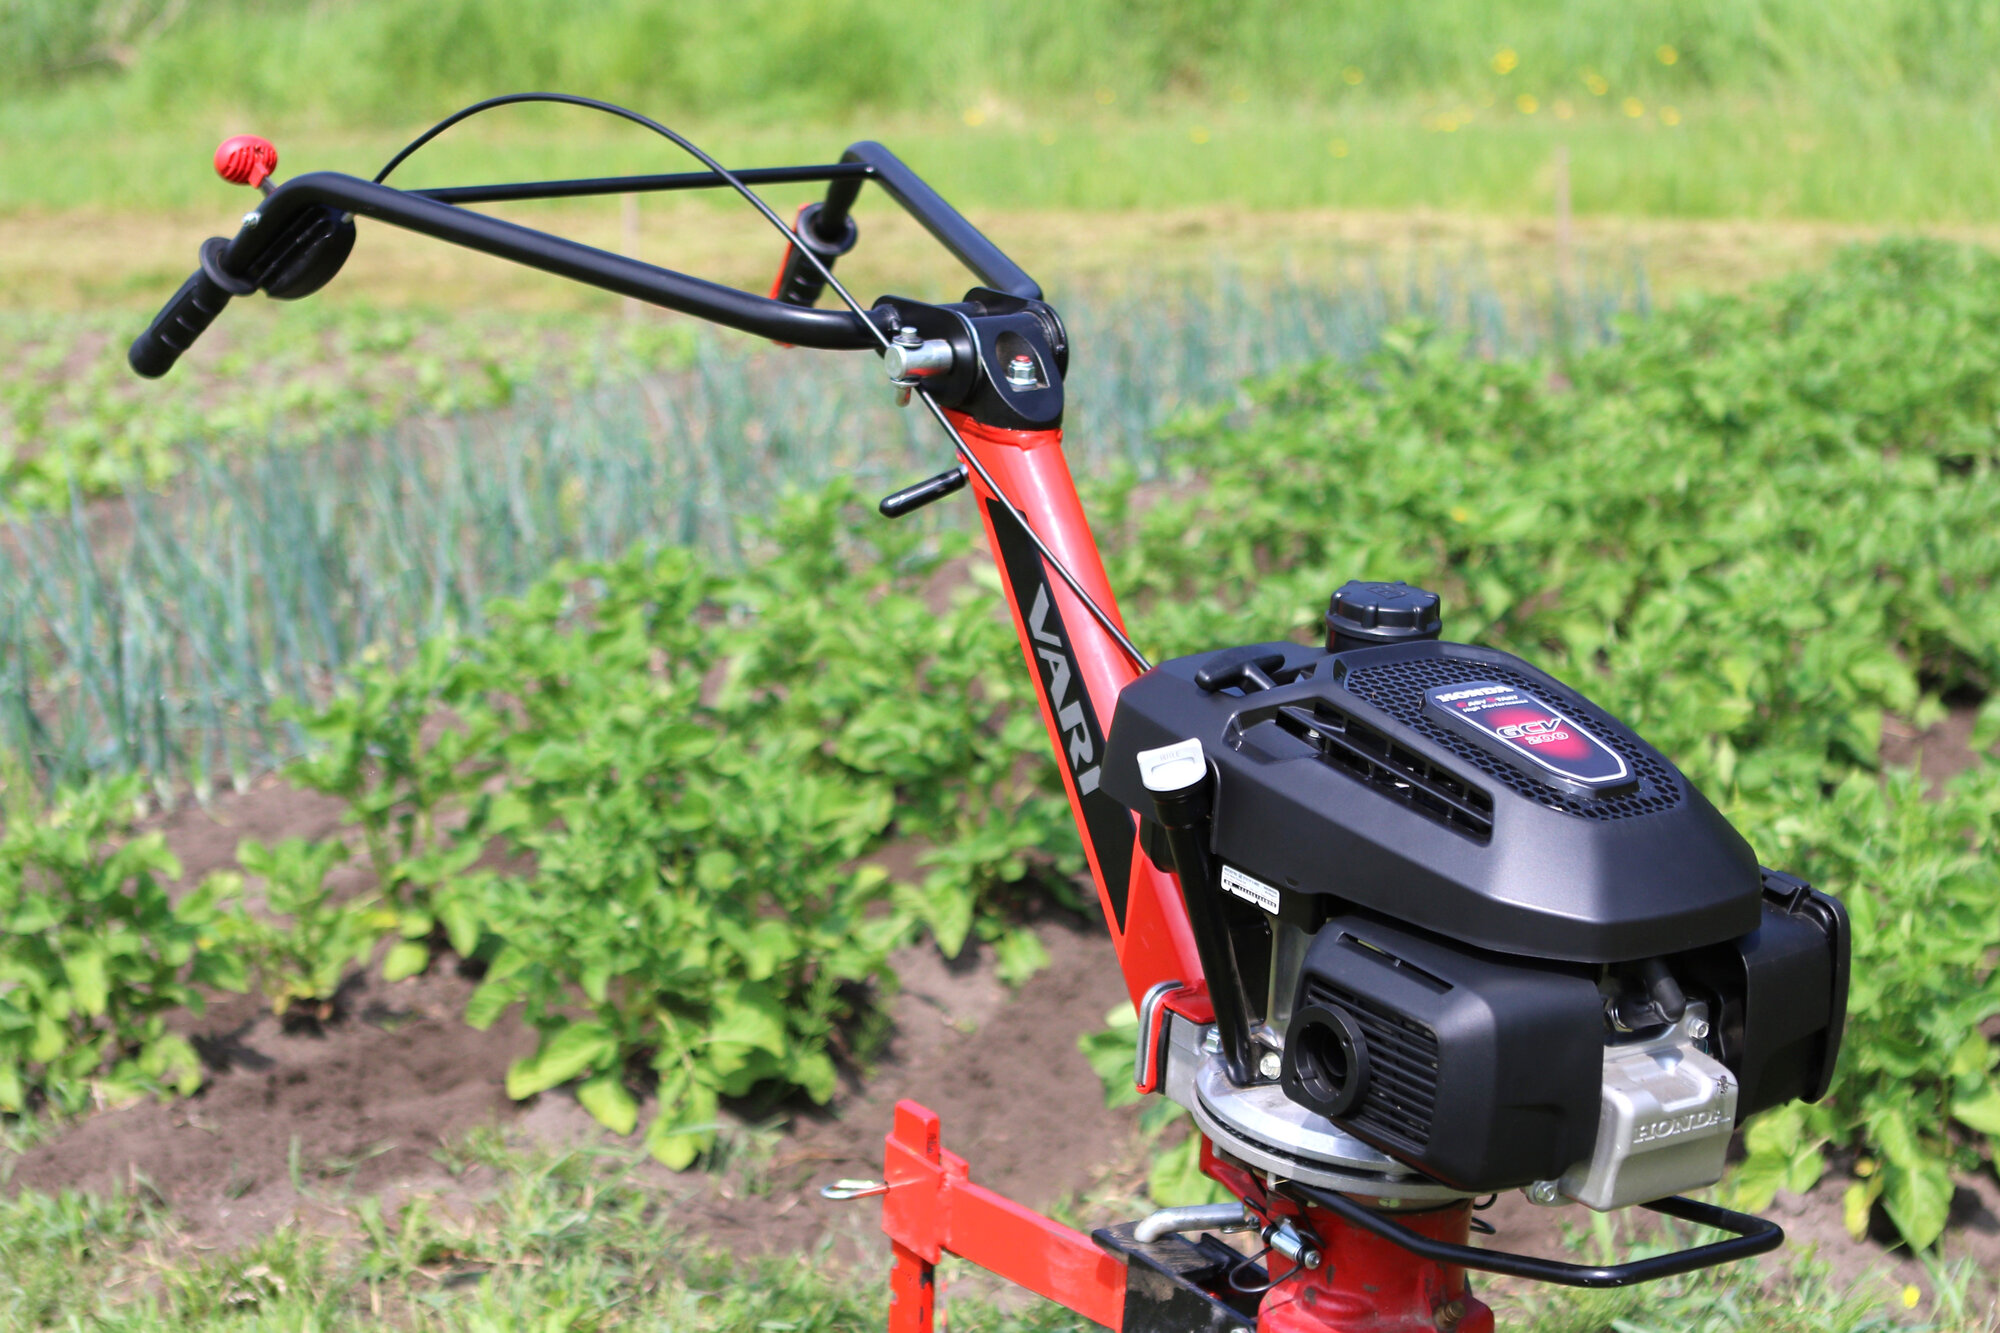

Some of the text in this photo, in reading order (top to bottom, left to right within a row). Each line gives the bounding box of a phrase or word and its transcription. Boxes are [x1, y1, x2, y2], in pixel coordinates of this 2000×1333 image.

[1029, 582, 1101, 796] VARI
[1435, 686, 1514, 702] HONDA
[1496, 718, 1561, 739] GCV
[1525, 732, 1569, 745] 200
[1633, 1110, 1731, 1143] HONDA
